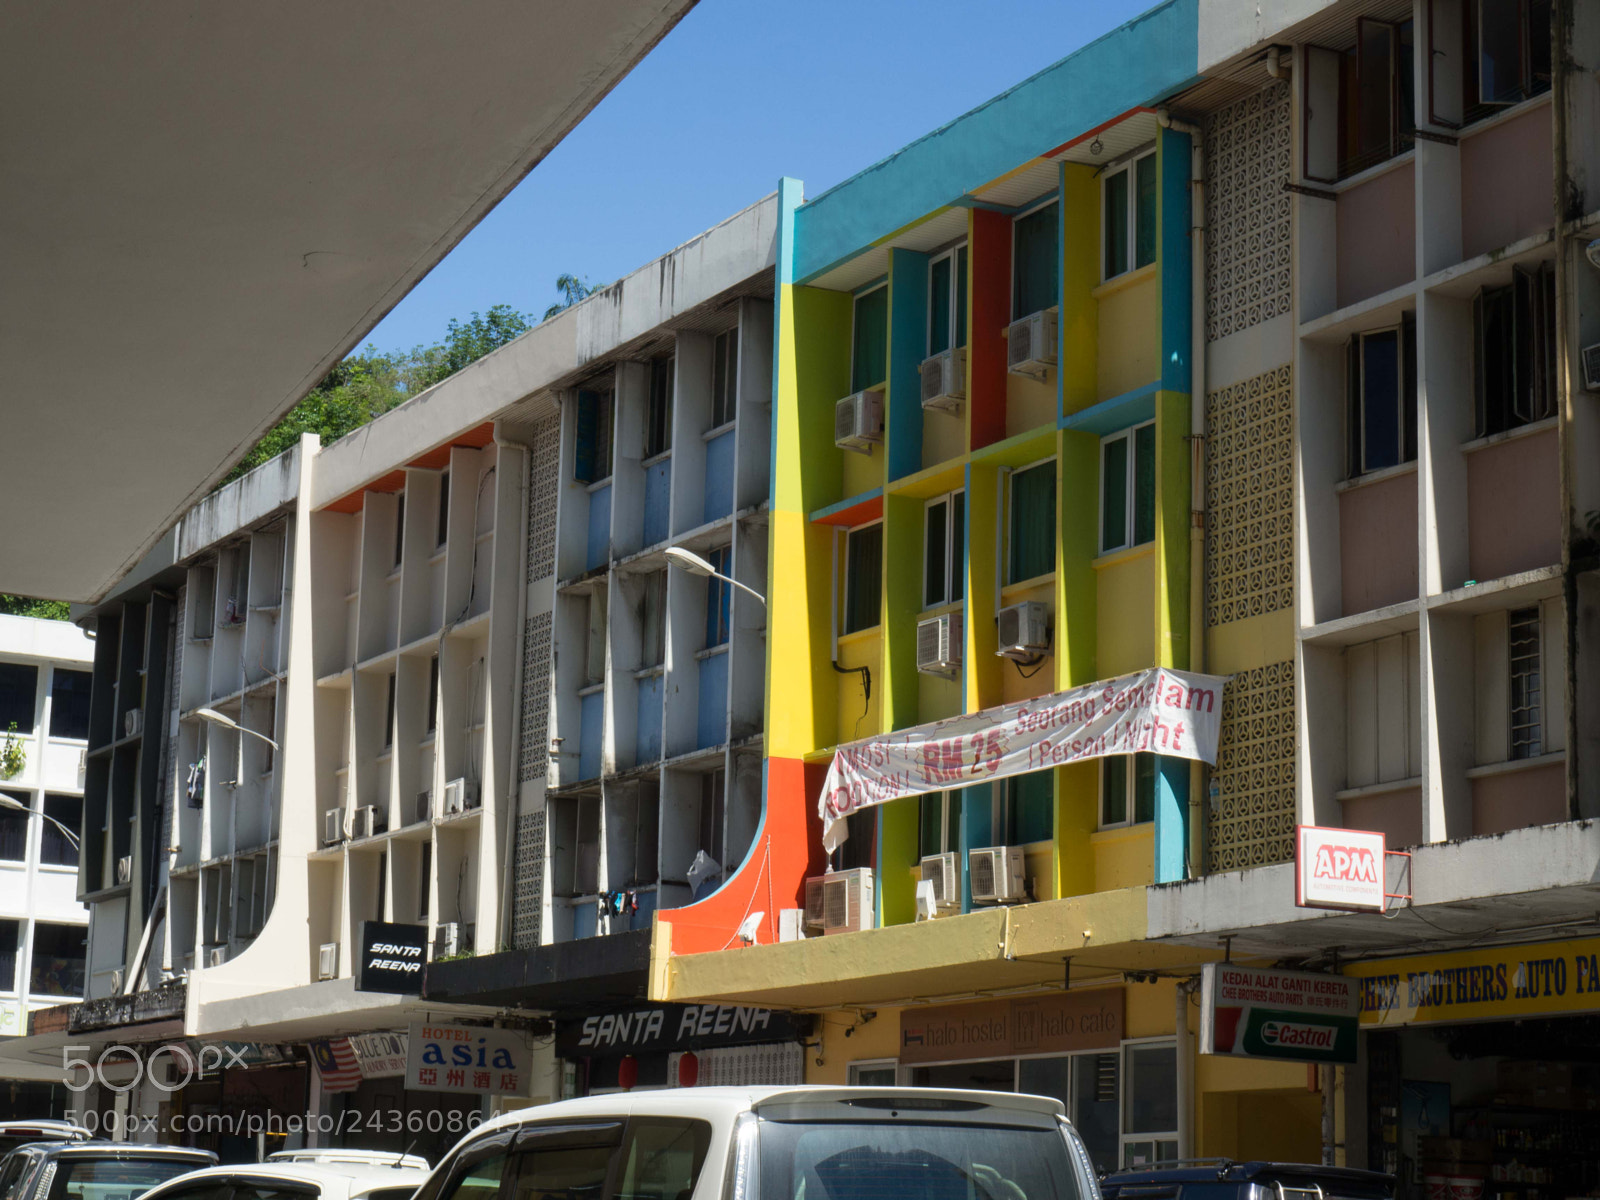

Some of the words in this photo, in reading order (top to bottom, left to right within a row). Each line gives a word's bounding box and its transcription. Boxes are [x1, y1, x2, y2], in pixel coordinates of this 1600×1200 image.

[1015, 697, 1095, 735] Seorang
[1101, 674, 1214, 715] Semalam
[923, 736, 964, 784] RM
[970, 728, 1007, 775] 25
[1039, 734, 1106, 767] Person
[1313, 844, 1378, 883] APM
[370, 942, 422, 957] SANTA
[369, 959, 421, 973] REENA
[1222, 971, 1253, 987] KEDAI
[1255, 974, 1279, 989] ALAT
[1281, 977, 1312, 992] GANTI
[1313, 980, 1349, 996] KERETA
[1222, 986, 1237, 999] CHEE
[1238, 988, 1268, 1003] BROTHERS
[1268, 991, 1284, 1005] AUTO
[1285, 993, 1304, 1007] PARTS
[1407, 963, 1508, 1009] BROTHERS
[1515, 957, 1567, 999] AUTO
[421, 1027, 473, 1042] HOTEL
[578, 1009, 665, 1048] SANTA
[676, 1004, 772, 1042] REENA
[926, 1022, 957, 1047] halo
[962, 1016, 1007, 1044] hostel
[1040, 1009, 1075, 1037] halo
[1279, 1024, 1333, 1047] Castrol
[421, 1037, 517, 1070] asia
